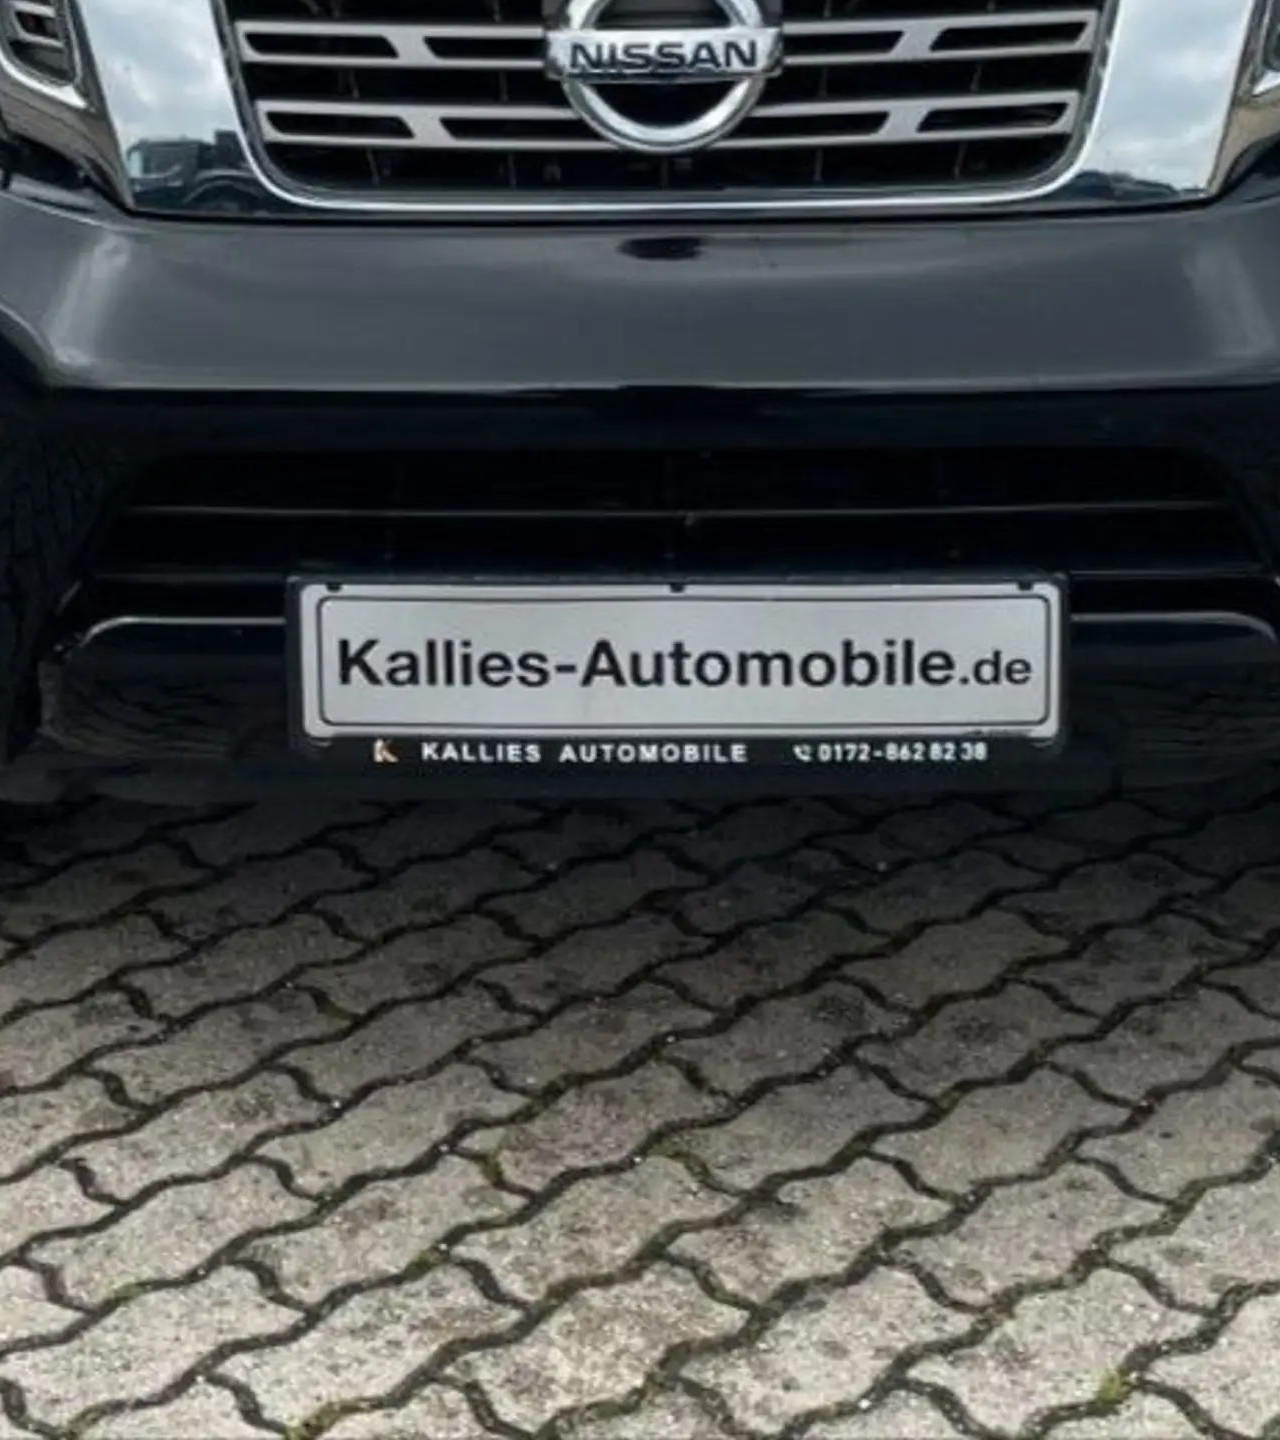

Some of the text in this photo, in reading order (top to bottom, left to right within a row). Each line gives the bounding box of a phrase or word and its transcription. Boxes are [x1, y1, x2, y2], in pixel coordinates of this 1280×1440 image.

[570, 41, 757, 69] NISSAN
[337, 638, 1033, 688] Kallies-Automobile.de
[420, 741, 542, 762] KALLIES
[558, 742, 748, 763] AUTOMOBILE
